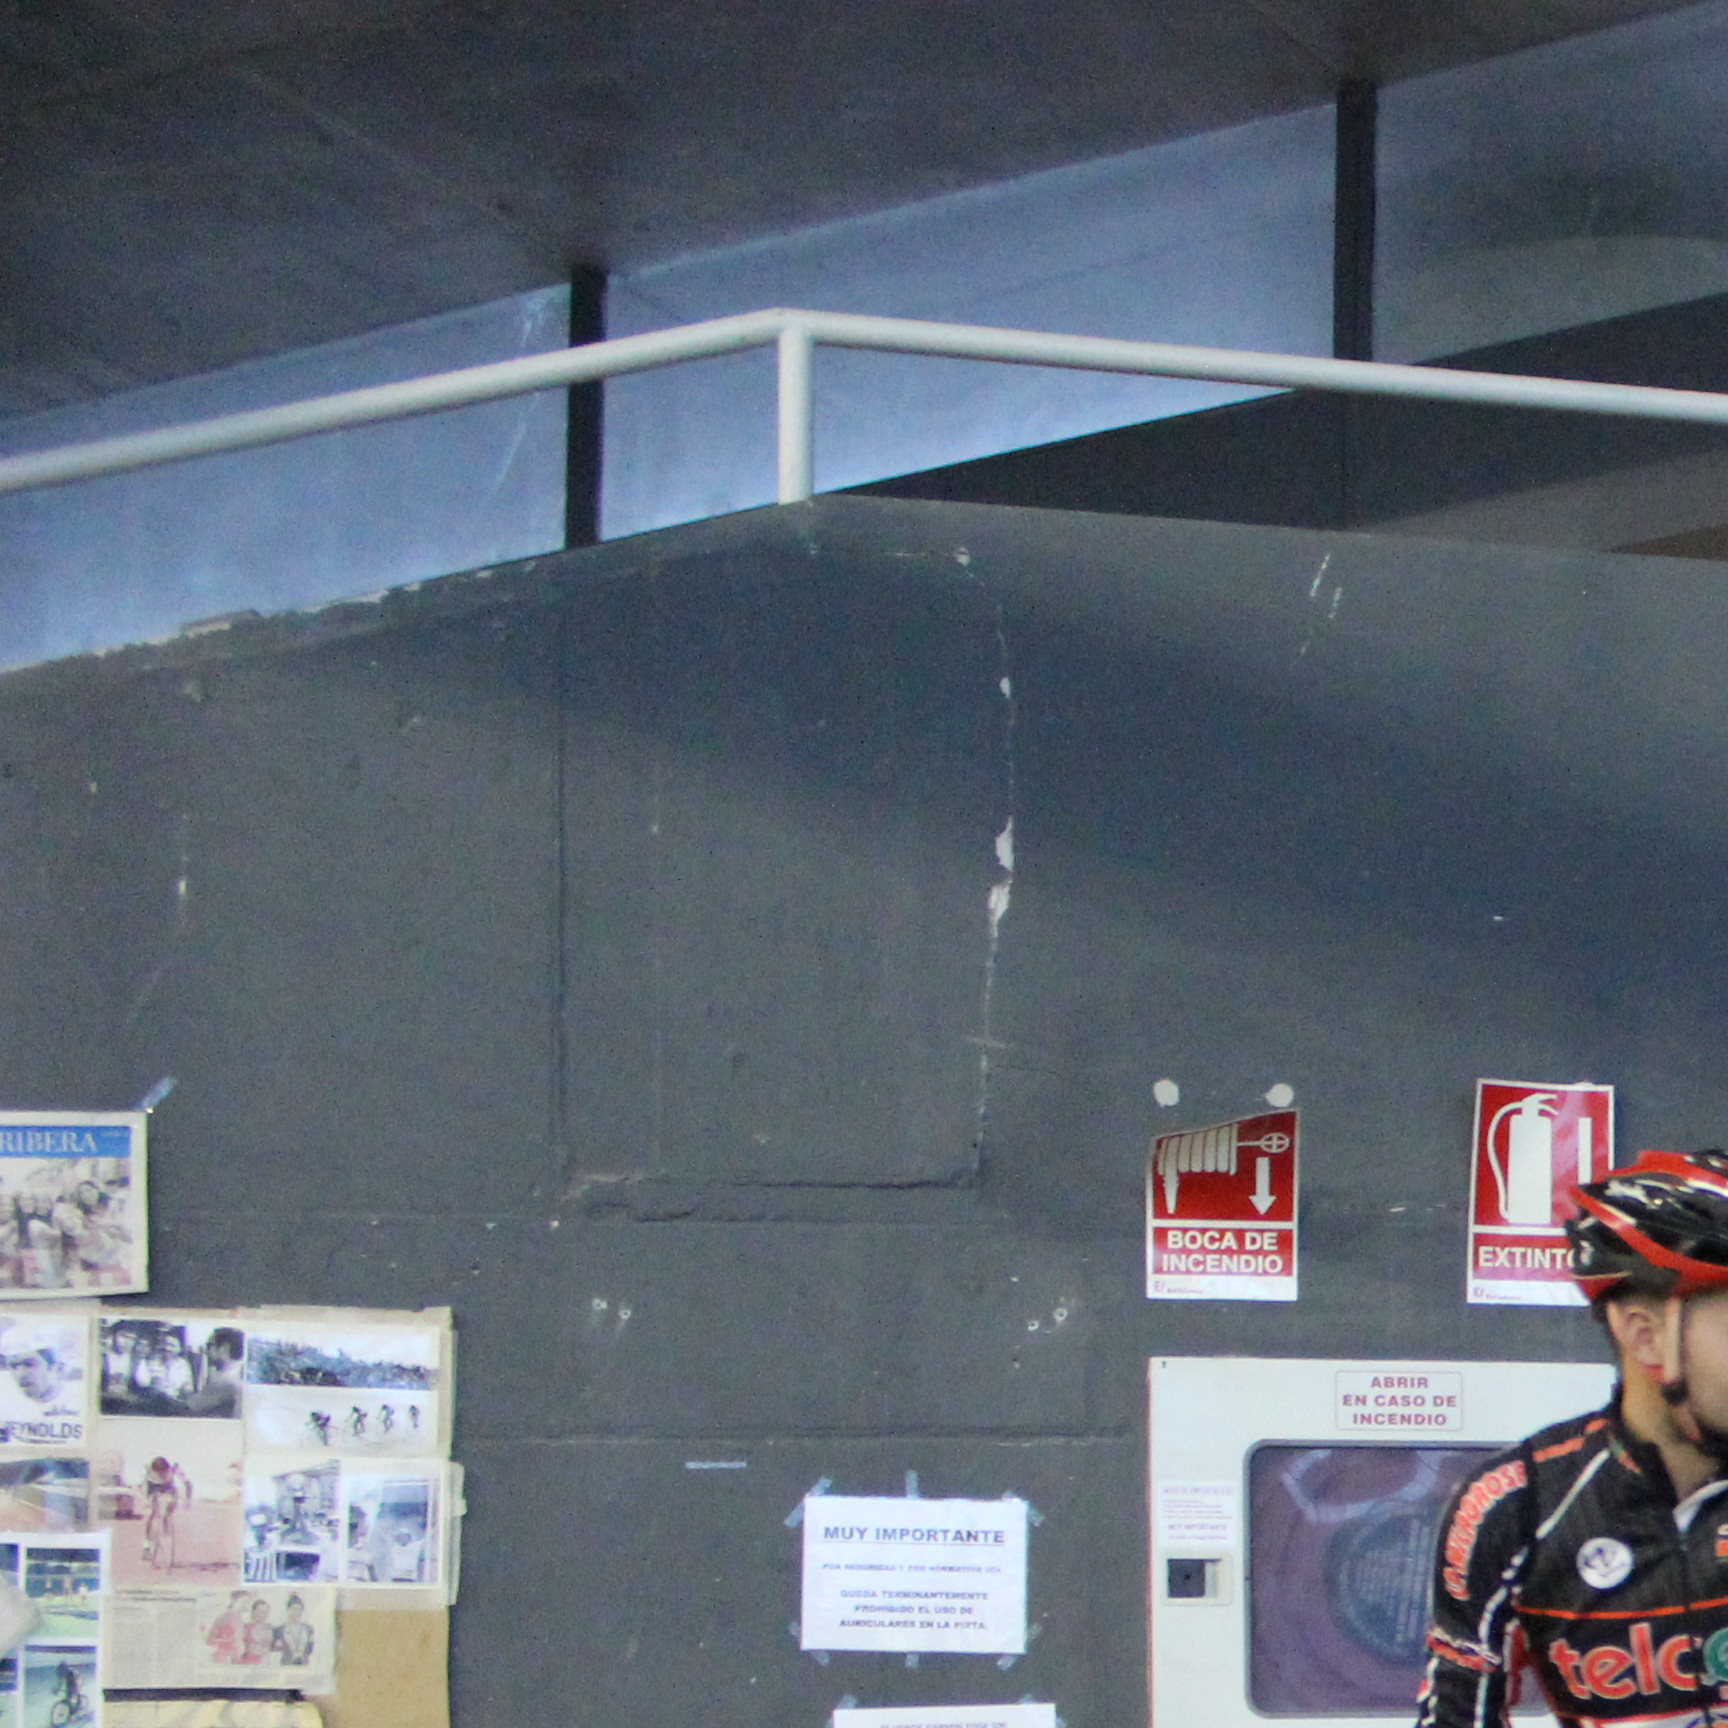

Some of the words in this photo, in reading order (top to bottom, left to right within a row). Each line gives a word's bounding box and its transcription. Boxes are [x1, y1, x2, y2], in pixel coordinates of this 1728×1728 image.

[1166, 1230, 1238, 1250] BOCA
[1244, 1231, 1279, 1251] DE
[1162, 1254, 1284, 1274] INCENDIO
[1371, 1377, 1428, 1389] ABRIR
[1342, 1395, 1367, 1406] EN
[1374, 1395, 1426, 1407] CASO
[1433, 1396, 1457, 1408] DE
[1353, 1413, 1447, 1425] INCENDIO
[3, 1421, 84, 1439] EYNOLDS
[823, 1527, 868, 1541] MUY
[875, 1528, 1005, 1544] IMPORTANTE
[840, 1589, 878, 1598] QUEDA
[882, 1590, 988, 1600] TERMINANTEMENTE
[854, 1605, 915, 1613] PROHIBIDO
[918, 1606, 930, 1614] EL
[934, 1606, 956, 1614] USO
[959, 1606, 974, 1615] DE
[839, 1620, 916, 1628] AURICULARES
[919, 1621, 934, 1629] EN
[937, 1621, 951, 1629] LA
